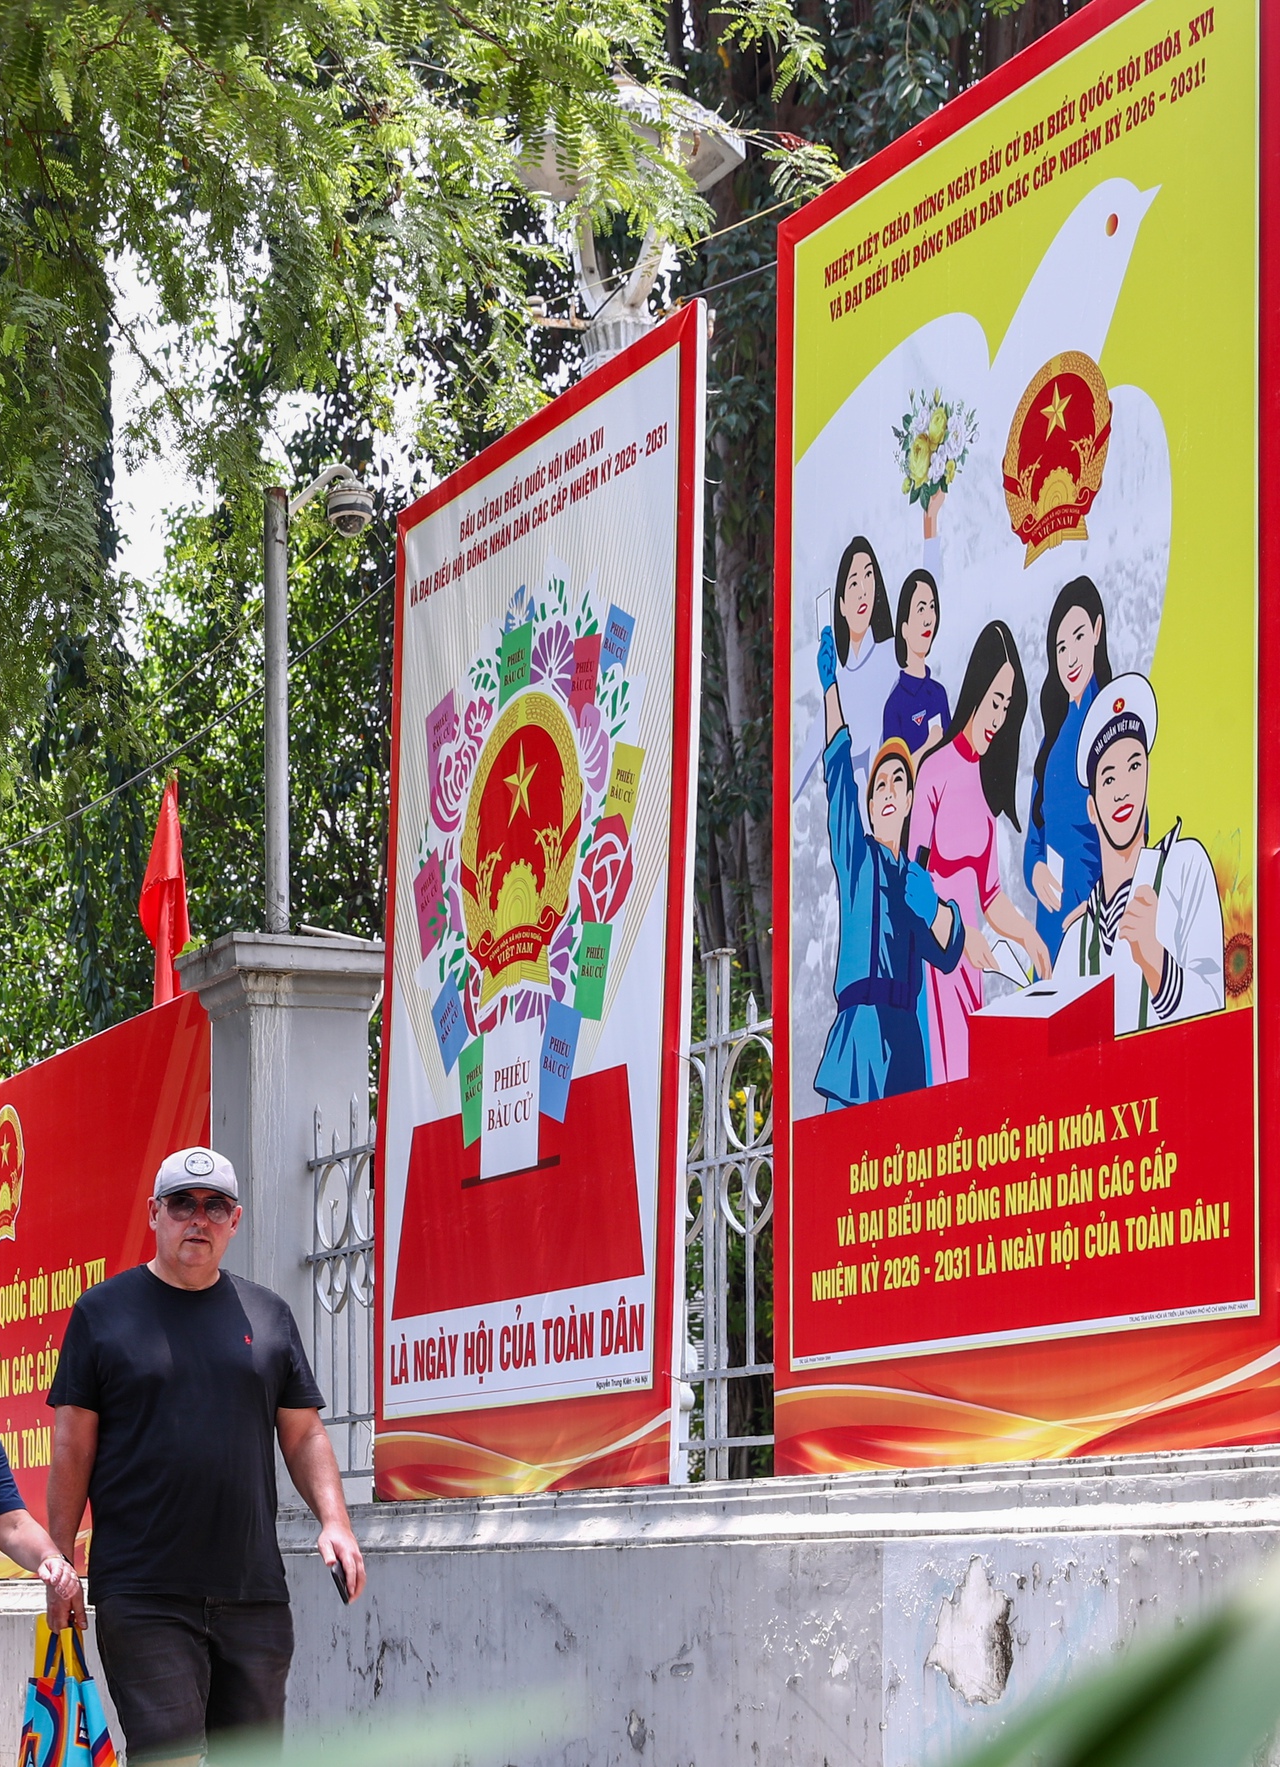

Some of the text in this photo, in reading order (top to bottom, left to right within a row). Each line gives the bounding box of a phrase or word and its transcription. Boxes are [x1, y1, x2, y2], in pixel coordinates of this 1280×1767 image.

[824, 6, 1214, 288] NHIỆT LIỆT CHÀO MỪNG NGÀY BẦU CỬ ĐẠI BIỂU QUỐC HỘI KHÓA XVI
[830, 291, 843, 323] VÀ
[845, 282, 863, 313] ĐẠI
[865, 259, 889, 300] BIỂU
[891, 249, 911, 283] HỘI
[913, 230, 943, 269] ĐỒNG
[946, 208, 977, 248] NHÂN
[980, 189, 1004, 226] DÂN
[1006, 172, 1030, 208] CÁC
[1033, 151, 1057, 191] CẤP
[1060, 126, 1102, 175] NHIỆM
[1105, 108, 1122, 146] KỲ
[1125, 91, 1155, 133] 2026
[1170, 57, 1206, 104] 2031!
[410, 580, 418, 608] VÀ
[419, 575, 433, 602] ĐẠI
[434, 557, 451, 593] BIỂU
[452, 551, 465, 582] HỘI
[466, 538, 488, 571] ĐỒNG
[489, 523, 511, 557] NHÂN
[513, 511, 530, 542] DÂN
[532, 498, 549, 529] CÁC
[550, 481, 568, 517] CẤP
[570, 466, 598, 505] NHIỆM
[601, 453, 613, 486] KỲ
[614, 441, 637, 477] 2026
[645, 421, 668, 457] 2031
[460, 426, 604, 543] BẦU CỬ ĐẠI BIỂU QUỐC HỘI KHÓA XVI
[1094, 719, 1140, 755] HẢI QUÂN VIỆT NAM
[497, 942, 534, 965] VIỆT NAM
[487, 1091, 534, 1132] BẦU CỬ
[493, 1056, 531, 1093] PHIẾU
[850, 1097, 1159, 1194] BẦU CỬ ĐẠI BIỂU QUỐC HỘI KHÓA XVI
[837, 1140, 1178, 1248] VÀ ĐẠI BIỂU HỘI ĐỒNG NHÂN DÂN CÁC CẤP
[29, 1266, 48, 1324] HỘI
[51, 1258, 82, 1312] KHÓA
[84, 1257, 106, 1290] XVI
[811, 1261, 857, 1305] NHIỆM
[861, 1254, 880, 1294] KỲ
[883, 1254, 920, 1290] 2026
[935, 1246, 970, 1282] 2031
[977, 1234, 997, 1276] LÀ
[1001, 1227, 1046, 1272] NGÀY
[1051, 1221, 1079, 1270] HỘI
[1084, 1210, 1120, 1259] CỦA
[1125, 1206, 1174, 1252] TOÀN
[12, 1346, 34, 1396] CÁC
[390, 1295, 645, 1386] LÀ NGÀY HỘI CỦA TOÀN DÂN
[611, 1379, 622, 1388] Trung
[22, 1419, 51, 1468] TOÀN
